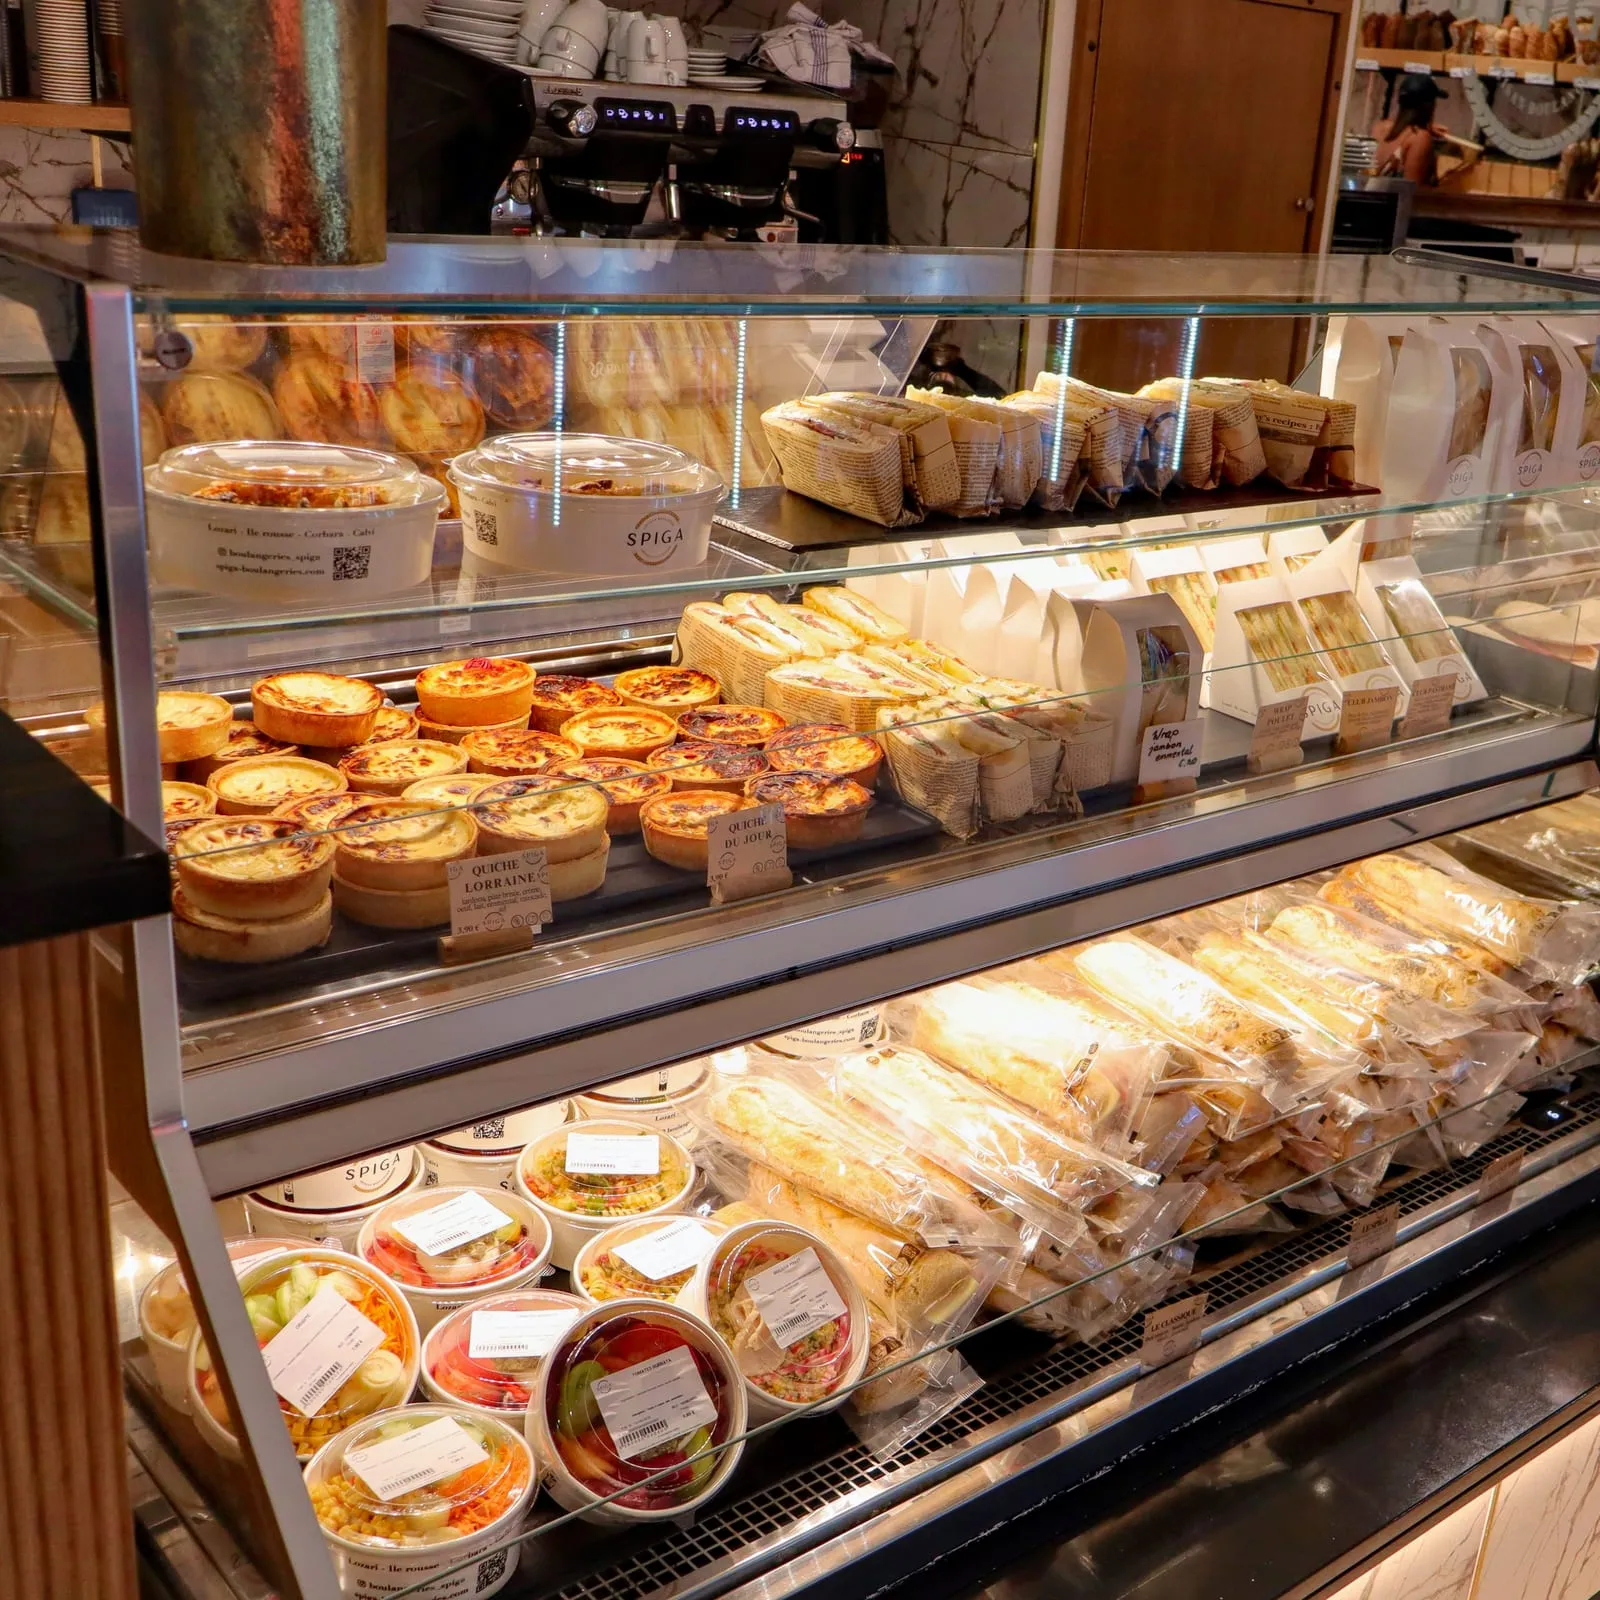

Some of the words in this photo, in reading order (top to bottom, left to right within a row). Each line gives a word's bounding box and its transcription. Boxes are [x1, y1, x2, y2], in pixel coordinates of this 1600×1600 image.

[1272, 417, 1307, 429] recipes
[1517, 463, 1543, 476] SPIGA
[1448, 471, 1474, 484] SPIGA
[304, 530, 344, 538] Corbara
[352, 528, 375, 537] Calvi
[626, 527, 684, 547] SPIGA
[1147, 742, 1182, 757] jambon
[725, 838, 740, 849] DU
[743, 830, 773, 845] JOUR
[472, 859, 520, 877] QUICHE
[465, 872, 536, 893] LORRAINE
[345, 1152, 400, 1181] SPIGA
[348, 1557, 378, 1571] Lozari
[405, 1563, 440, 1572] rousse
